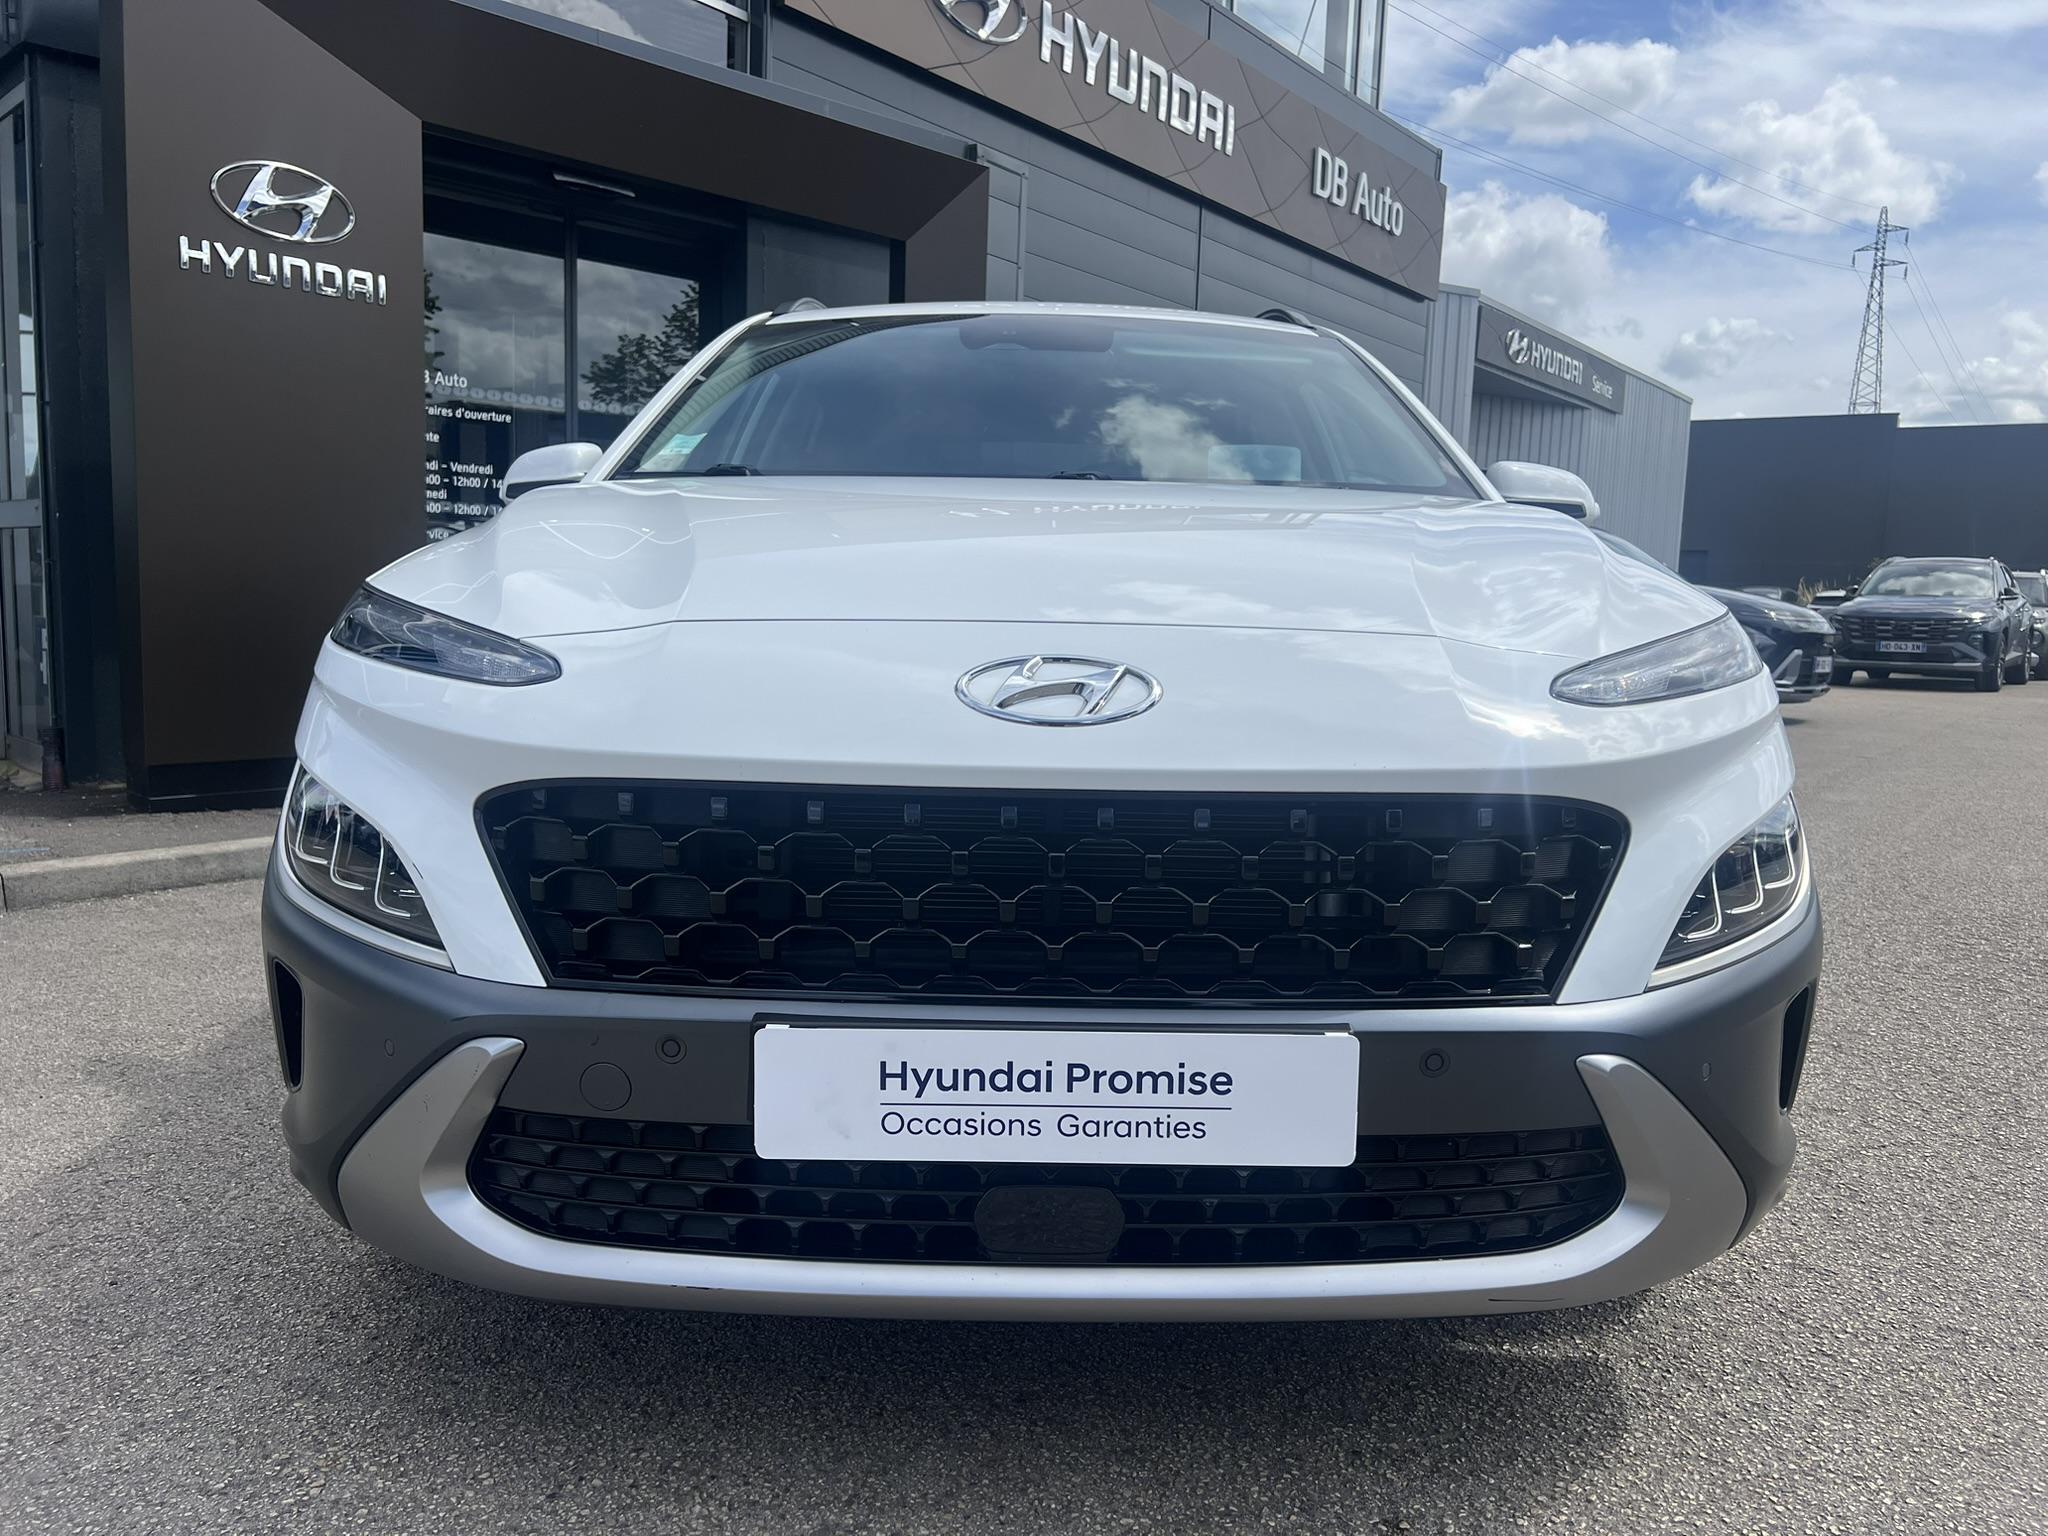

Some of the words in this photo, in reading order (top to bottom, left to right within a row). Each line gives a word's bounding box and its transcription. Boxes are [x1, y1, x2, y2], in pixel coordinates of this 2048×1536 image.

[1039, 0, 1236, 157] HYUNDAI
[1312, 146, 1348, 207] DB
[1351, 171, 1404, 237] Auto
[178, 235, 387, 306] HYUNDAI
[434, 371, 468, 388] Auto
[1530, 340, 1583, 385] HYUNDAI
[1591, 375, 1613, 399] Service
[455, 407, 512, 423] d'ouverture
[449, 461, 494, 475] Vendredi
[452, 475, 481, 488] 12h00
[453, 503, 481, 516] 12h00
[879, 1060, 1053, 1099] Hyundai
[1066, 1062, 1234, 1096] Promise
[880, 1110, 1042, 1137] Occasions
[1056, 1113, 1207, 1140] Garanties
